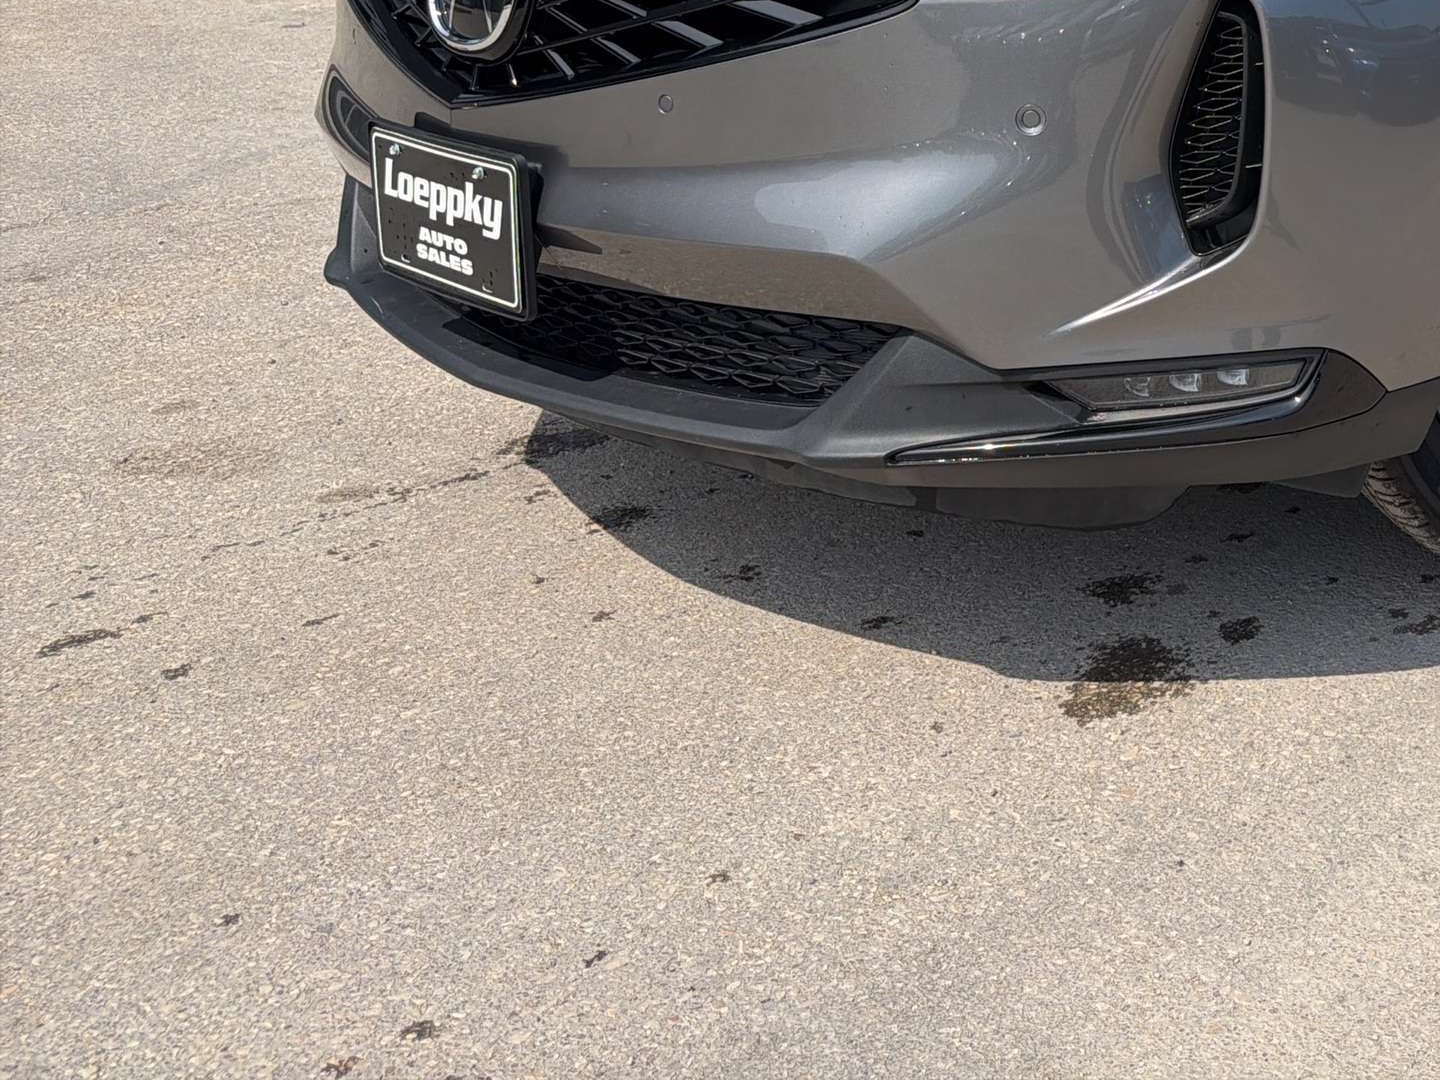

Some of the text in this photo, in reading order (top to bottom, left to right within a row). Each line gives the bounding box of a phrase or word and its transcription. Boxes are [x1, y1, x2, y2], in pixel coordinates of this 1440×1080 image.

[384, 157, 503, 241] Loeppky
[419, 226, 468, 256] AUTO
[416, 243, 474, 276] SALES
